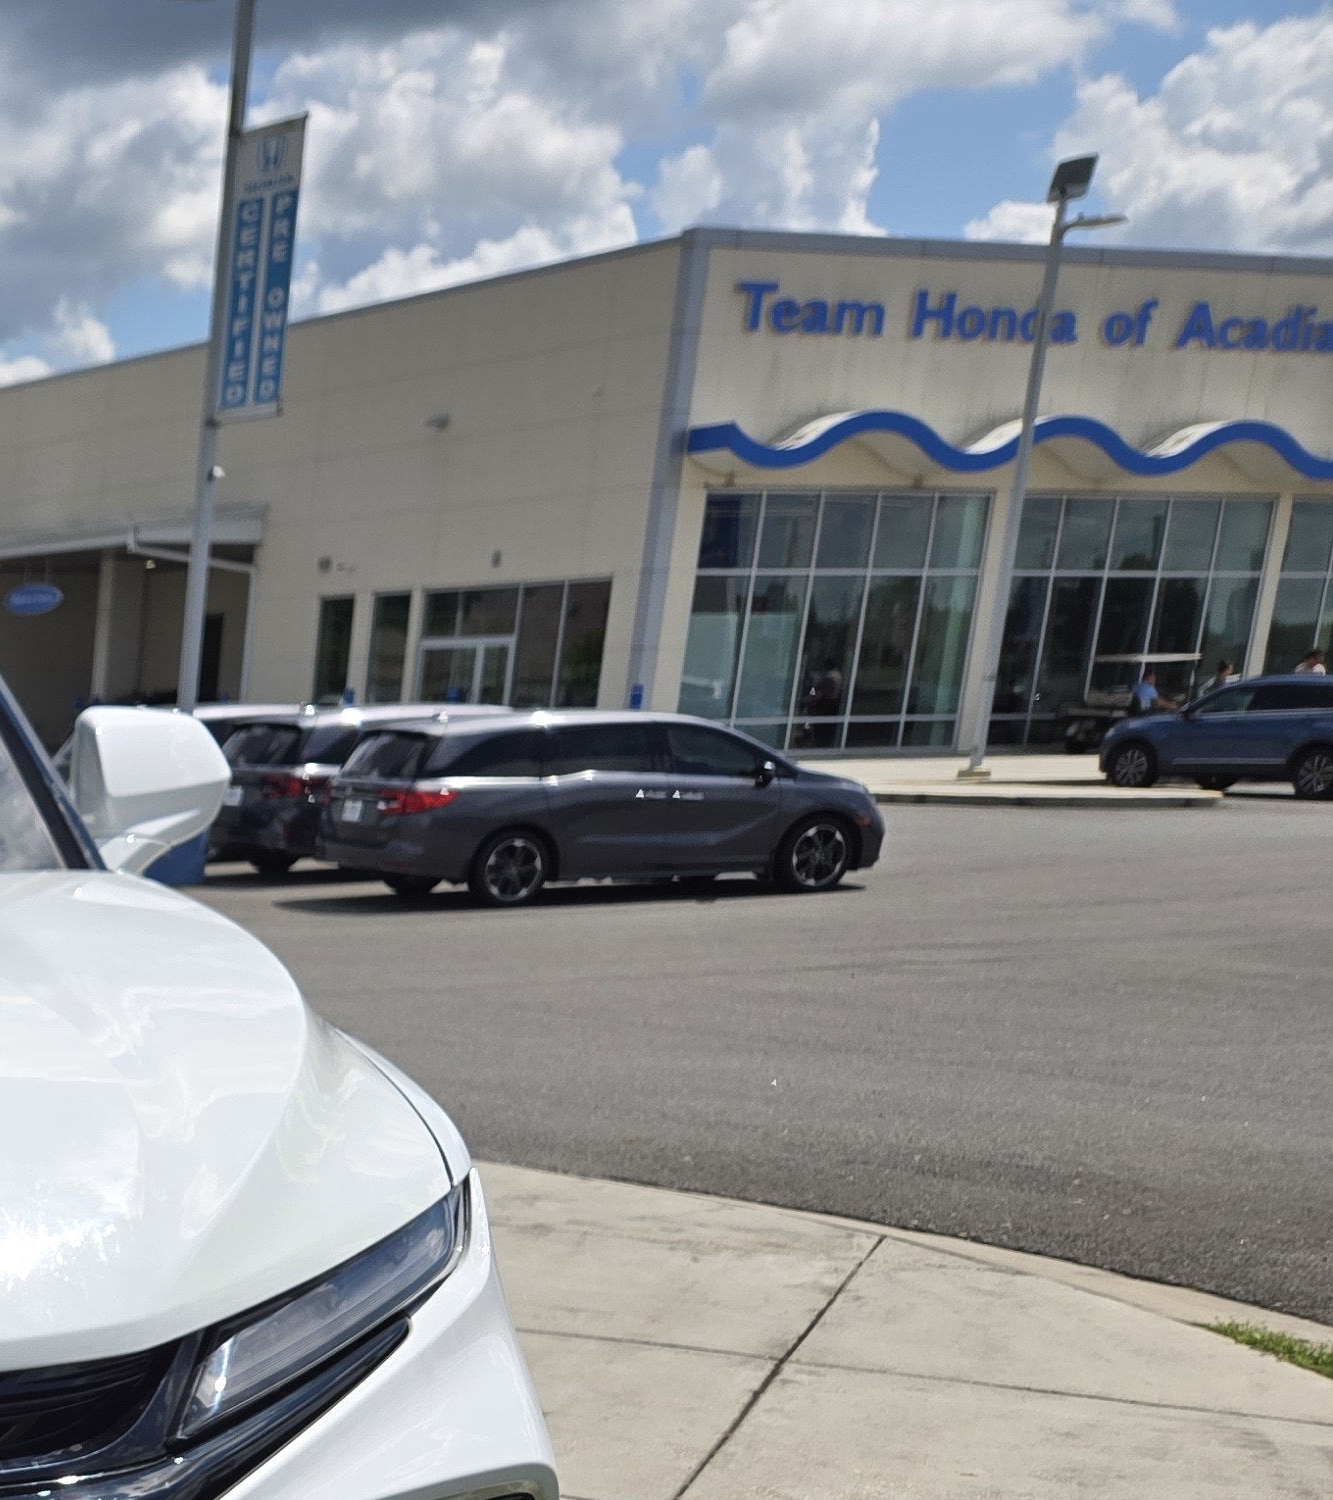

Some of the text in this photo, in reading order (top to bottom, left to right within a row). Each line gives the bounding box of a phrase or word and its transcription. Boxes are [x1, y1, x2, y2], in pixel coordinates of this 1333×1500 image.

[225, 202, 261, 402] CERTIFIED
[258, 286, 285, 399] OWNED
[735, 279, 886, 338] Team
[1101, 297, 1160, 349] of
